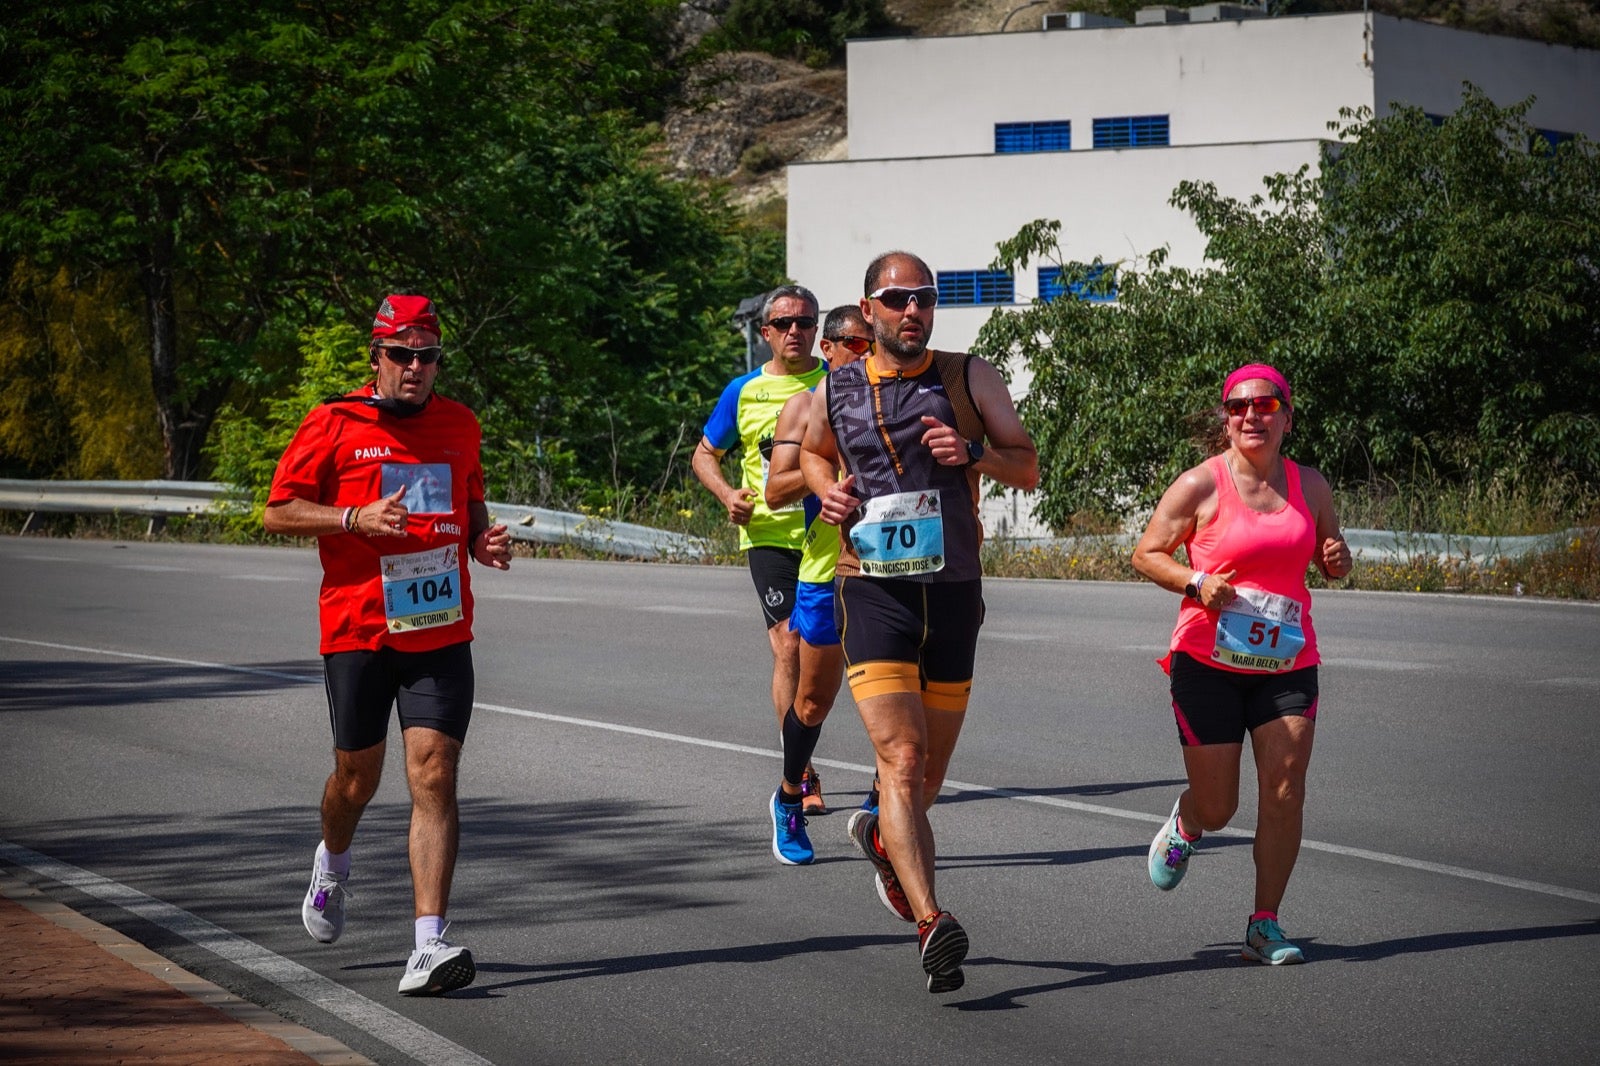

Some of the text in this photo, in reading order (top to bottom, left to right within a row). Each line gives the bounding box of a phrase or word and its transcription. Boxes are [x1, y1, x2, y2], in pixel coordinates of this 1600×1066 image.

[355, 446, 391, 460] PAULA
[881, 524, 916, 551] 70
[871, 561, 910, 574] FRANCISCO
[406, 576, 453, 605] 104
[410, 611, 449, 627] VICTORINO
[1248, 621, 1281, 649] 51
[1231, 653, 1255, 666] MARIA
